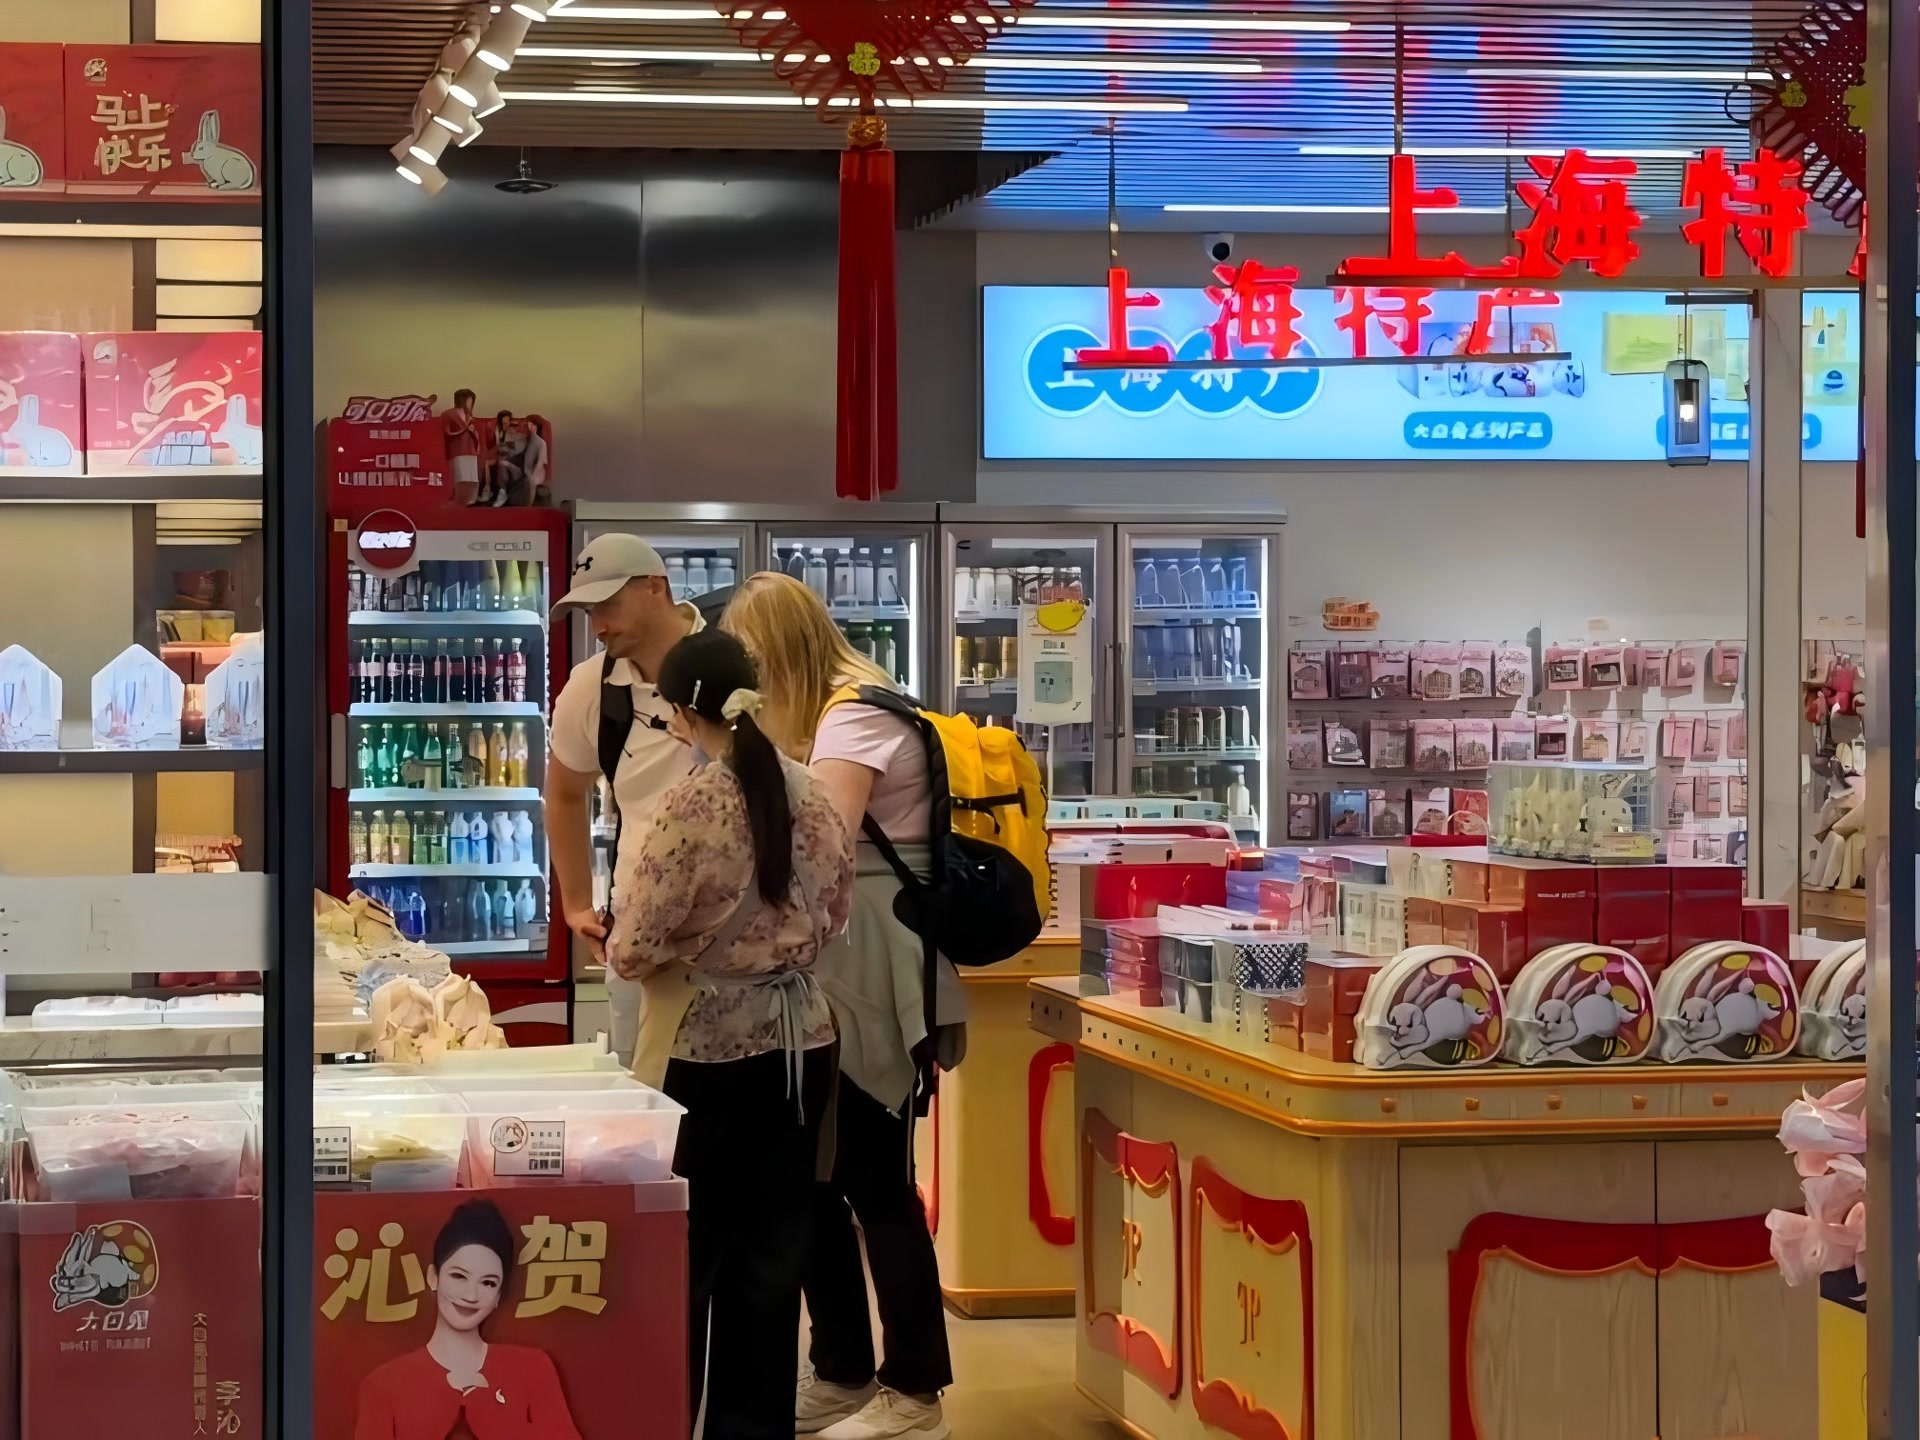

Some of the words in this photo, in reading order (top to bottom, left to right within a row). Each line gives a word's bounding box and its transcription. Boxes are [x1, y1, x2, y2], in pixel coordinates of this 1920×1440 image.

[90, 93, 169, 131] 马上
[93, 133, 172, 175] 快乐
[1335, 147, 1867, 278] 上海特
